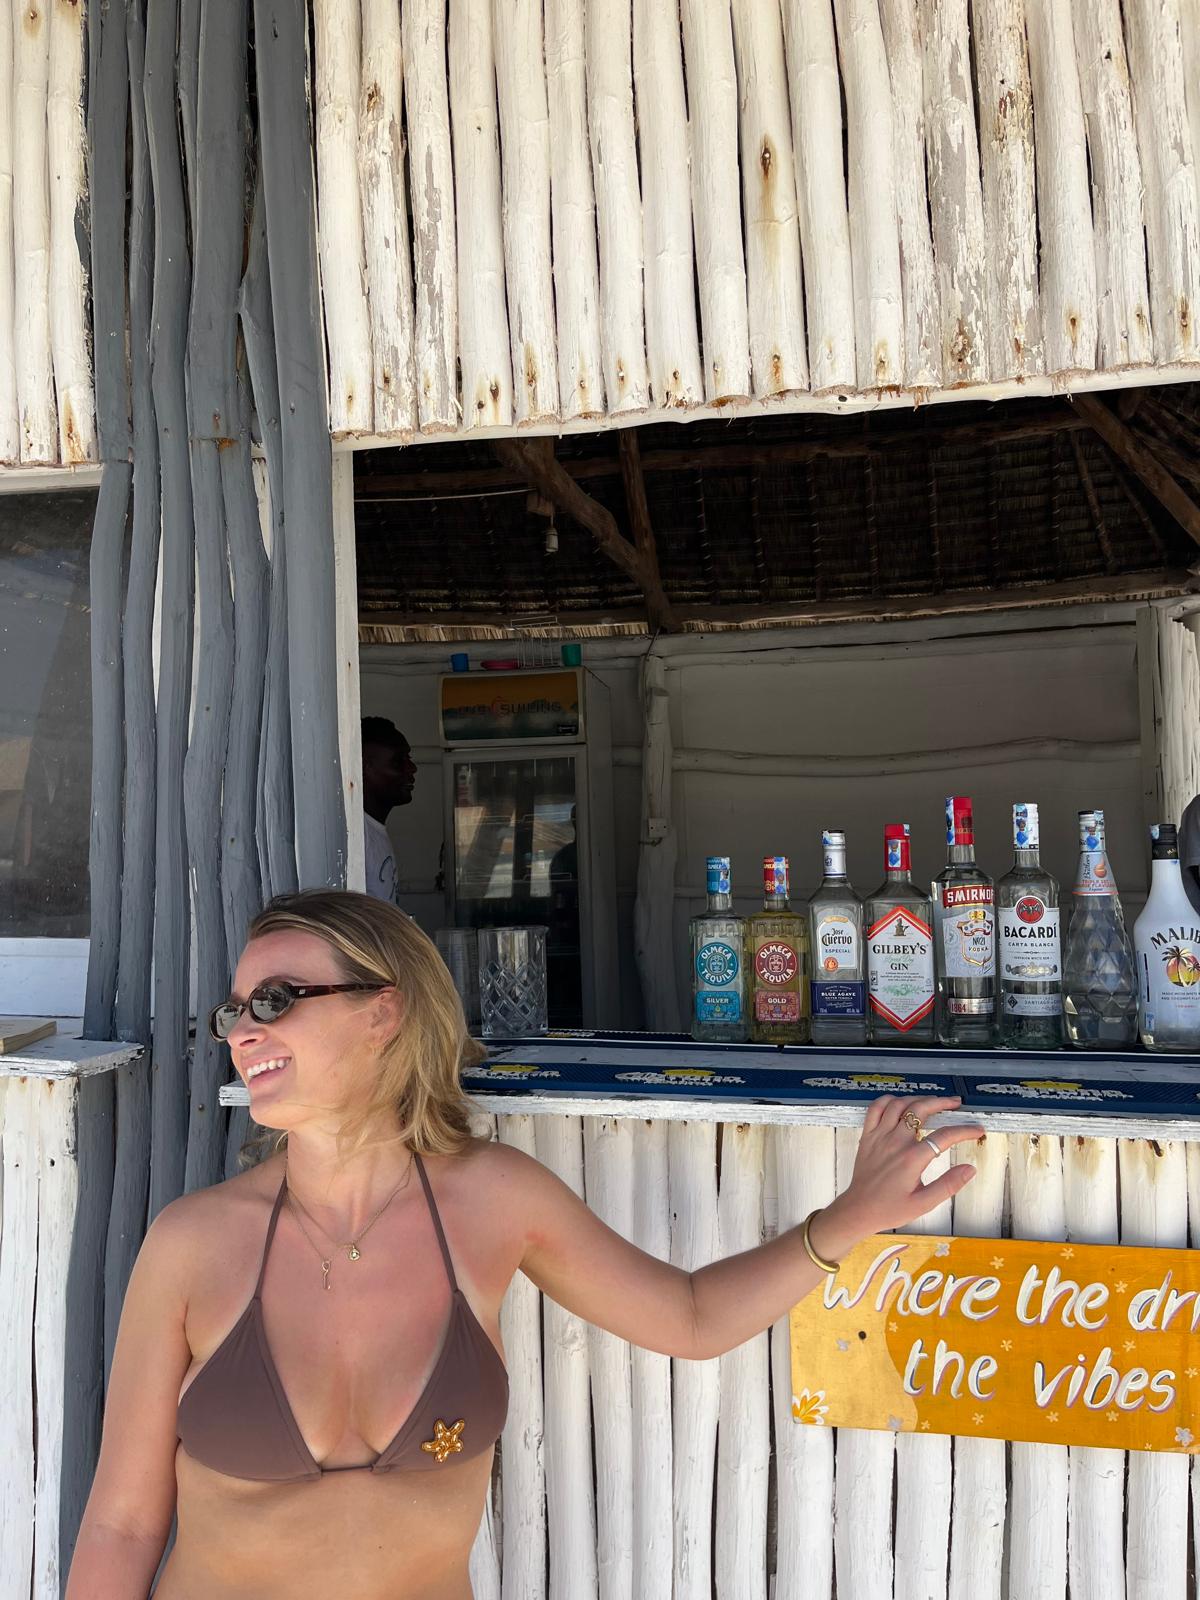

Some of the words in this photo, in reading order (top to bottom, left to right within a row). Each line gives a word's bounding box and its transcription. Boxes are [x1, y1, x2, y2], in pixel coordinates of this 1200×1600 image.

[1004, 922, 1057, 938] BACARDÍ
[821, 933, 852, 947] Cuervo
[872, 942, 927, 954] GILBEY'S
[701, 945, 732, 961] OLMECA
[759, 944, 792, 960] OLMECA
[890, 962, 909, 971] GIN
[701, 967, 735, 983] TEQUILA
[760, 967, 794, 983] TEQUILA
[951, 1003, 967, 1012] 1864
[823, 1243, 1001, 1321] Where
[1015, 1264, 1110, 1331] the
[903, 1338, 999, 1400] the
[1033, 1346, 1176, 1413] vibes
